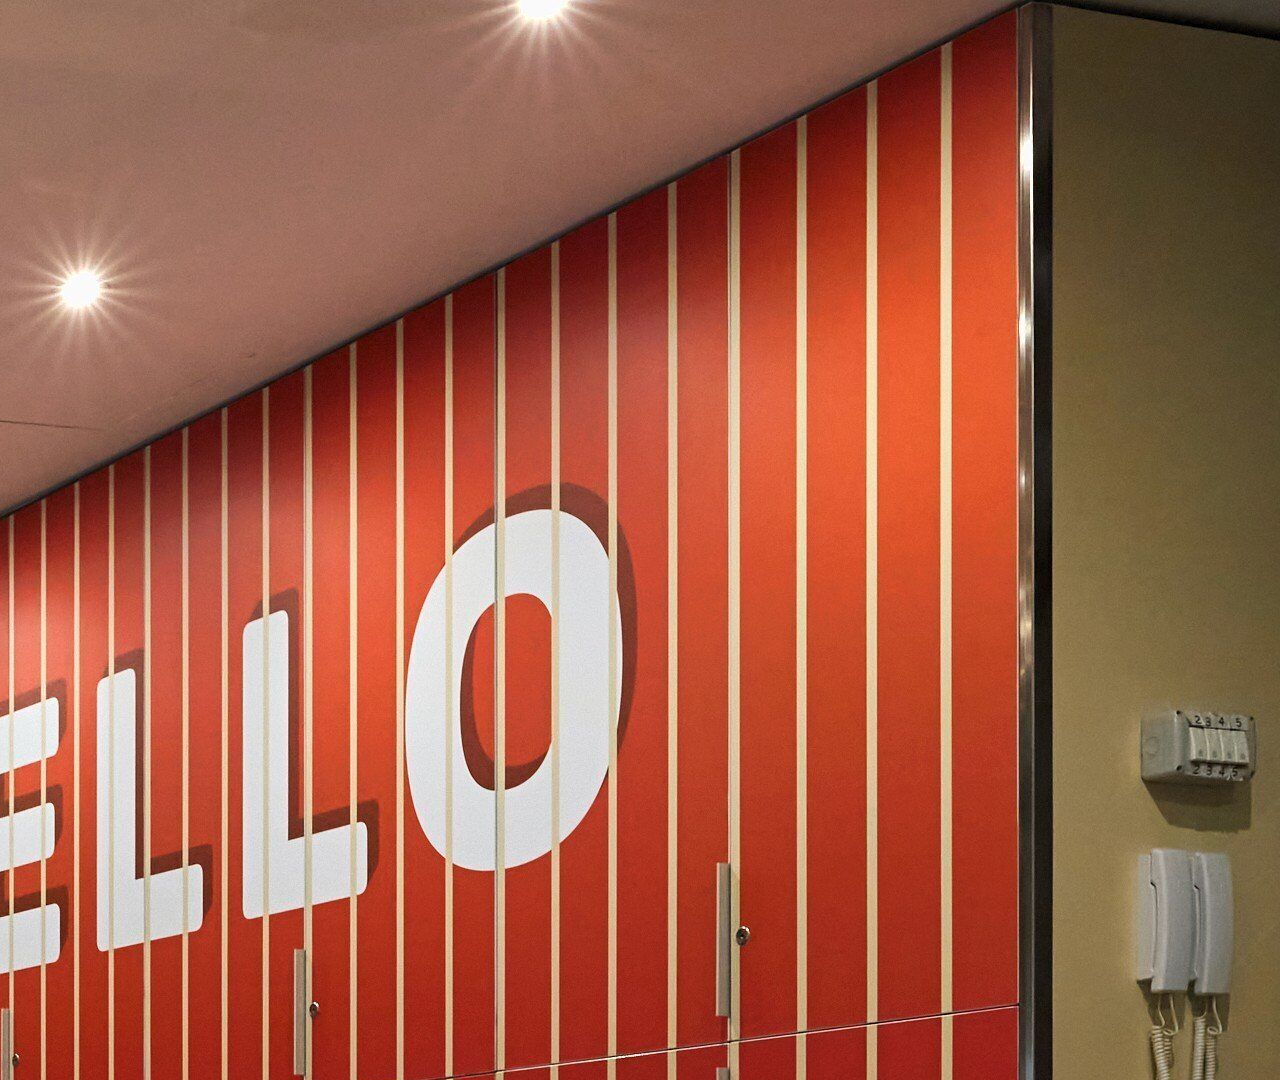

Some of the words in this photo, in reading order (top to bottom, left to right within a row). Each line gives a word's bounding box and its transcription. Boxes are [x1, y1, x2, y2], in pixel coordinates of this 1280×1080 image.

[1194, 715, 1202, 725] 2
[1219, 716, 1225, 726] 4
[1235, 718, 1242, 728] 5
[1193, 764, 1201, 775] 2
[1205, 766, 1213, 776] 3
[1232, 767, 1238, 777] 5
